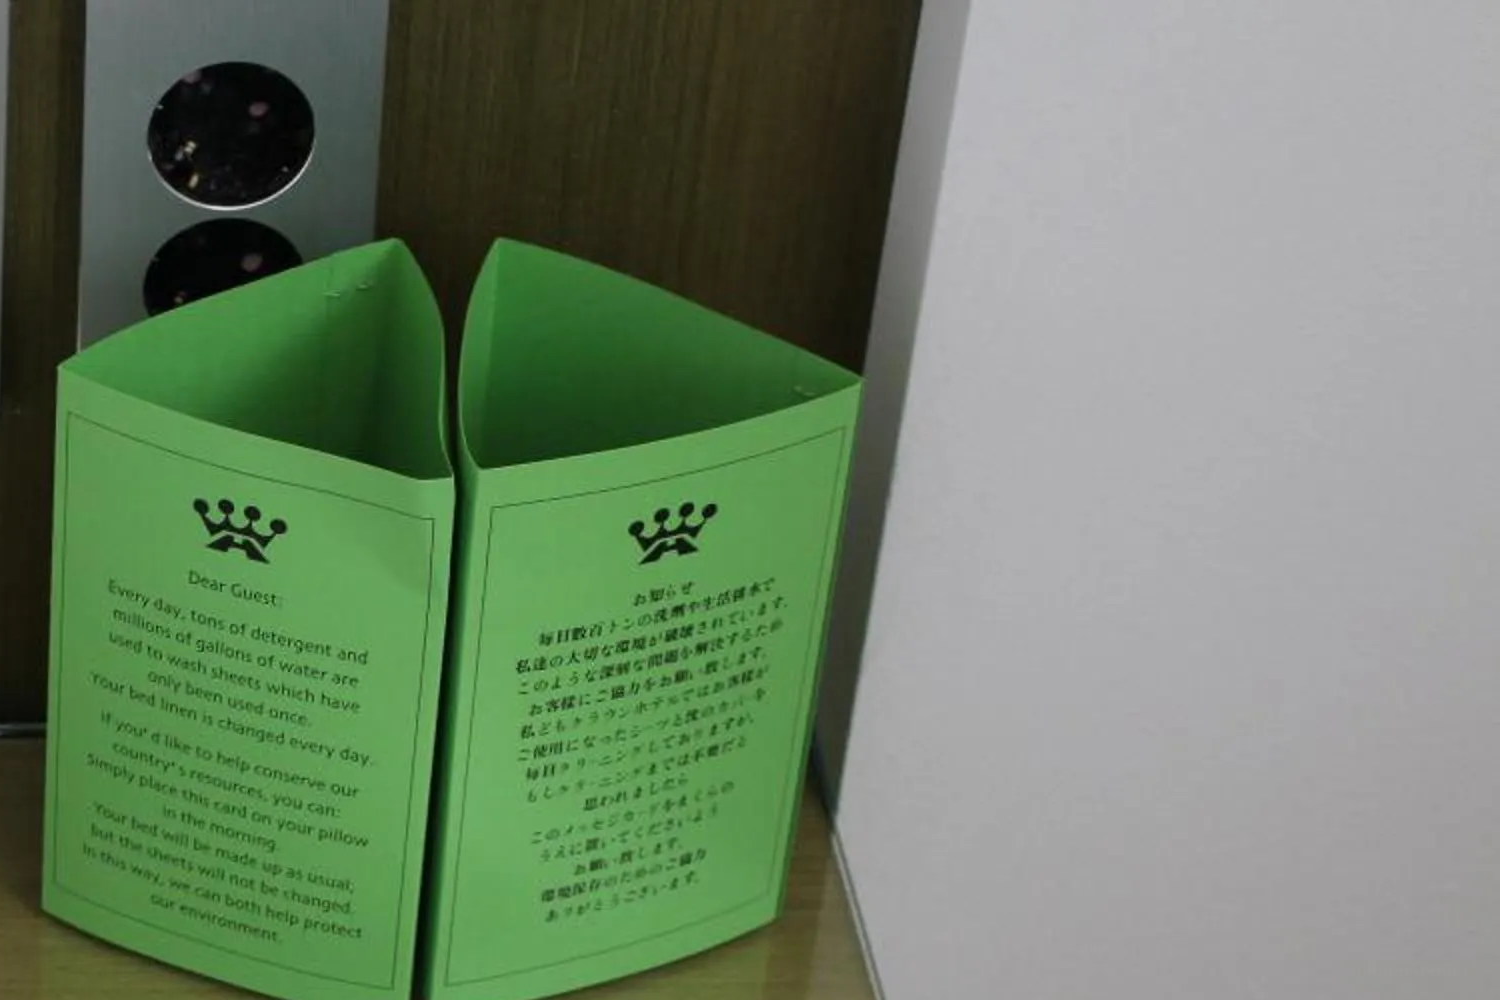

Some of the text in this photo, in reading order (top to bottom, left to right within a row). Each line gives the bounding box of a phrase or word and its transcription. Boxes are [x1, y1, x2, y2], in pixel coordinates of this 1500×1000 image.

[188, 570, 226, 592] Dear
[108, 578, 368, 665] Every day, tons of detergent and
[113, 609, 359, 687] millions of gallons of water are
[109, 632, 360, 713] used to wash sheets which have
[148, 671, 312, 727] only been used once.
[90, 671, 377, 767] Your bed linen is changed every day.
[86, 753, 368, 847] Simply place this card on your pillow
[165, 735, 192, 751] like
[196, 746, 212, 761] to
[217, 751, 249, 774] help
[254, 765, 326, 791] conserve
[330, 783, 359, 797] our
[272, 795, 303, 810] you
[94, 802, 127, 824] Your
[131, 816, 157, 837] bed
[162, 829, 188, 846] will
[193, 838, 211, 851] be
[215, 848, 256, 867] made
[262, 862, 282, 876] up
[286, 867, 303, 880] as
[180, 811, 206, 827] the
[91, 823, 114, 841] but
[119, 836, 142, 850] the
[147, 847, 193, 872] sheets
[198, 865, 225, 880] will
[229, 873, 254, 890] not
[260, 881, 279, 895] be
[100, 851, 126, 871] this
[130, 864, 165, 886] way,
[169, 879, 190, 890] we
[195, 886, 221, 902] can
[225, 894, 261, 914] both
[266, 905, 299, 926] help
[304, 918, 362, 938] protect
[150, 895, 175, 908] our
